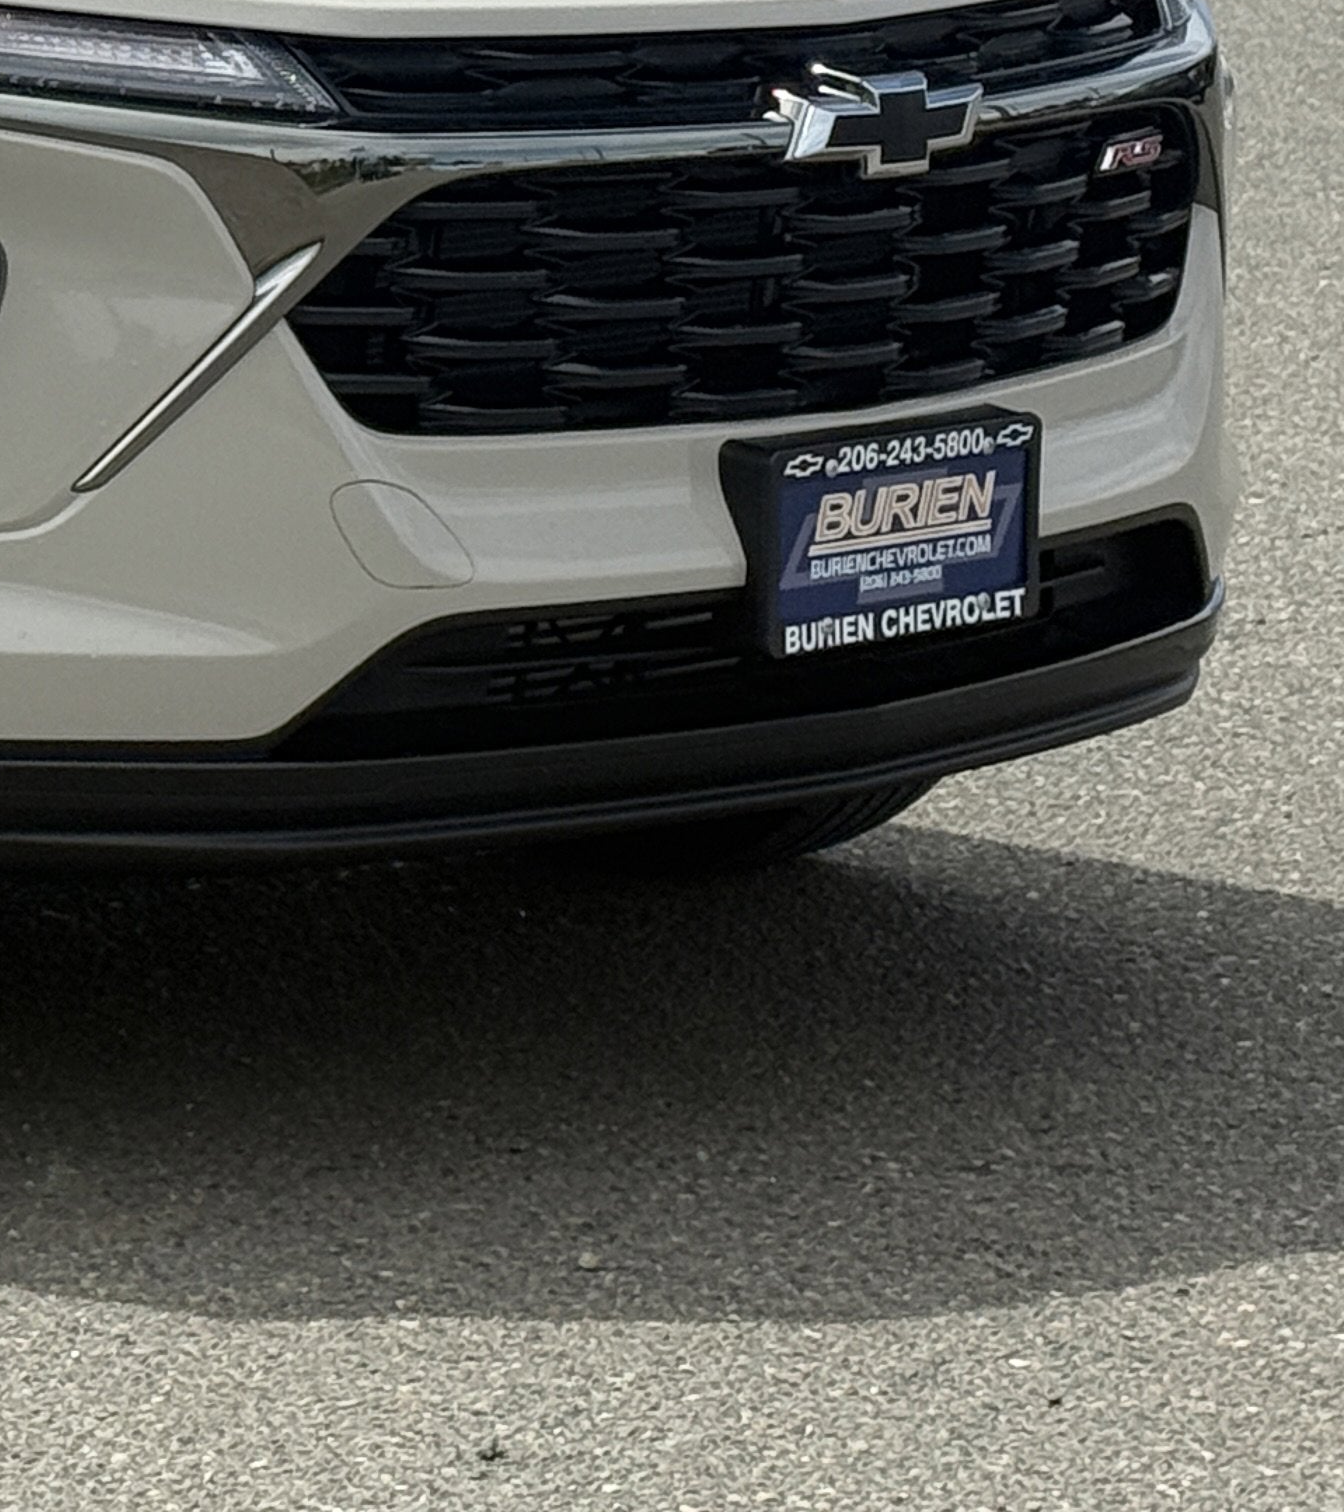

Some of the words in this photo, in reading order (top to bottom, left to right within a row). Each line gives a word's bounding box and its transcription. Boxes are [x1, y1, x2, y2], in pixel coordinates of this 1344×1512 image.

[837, 427, 985, 473] 206-243-5800
[815, 470, 996, 542] BURIEN
[811, 533, 992, 580] BURIENCHEVROLET.COM
[785, 612, 874, 654] BURIEN
[881, 587, 1026, 638] CHEVROLET
